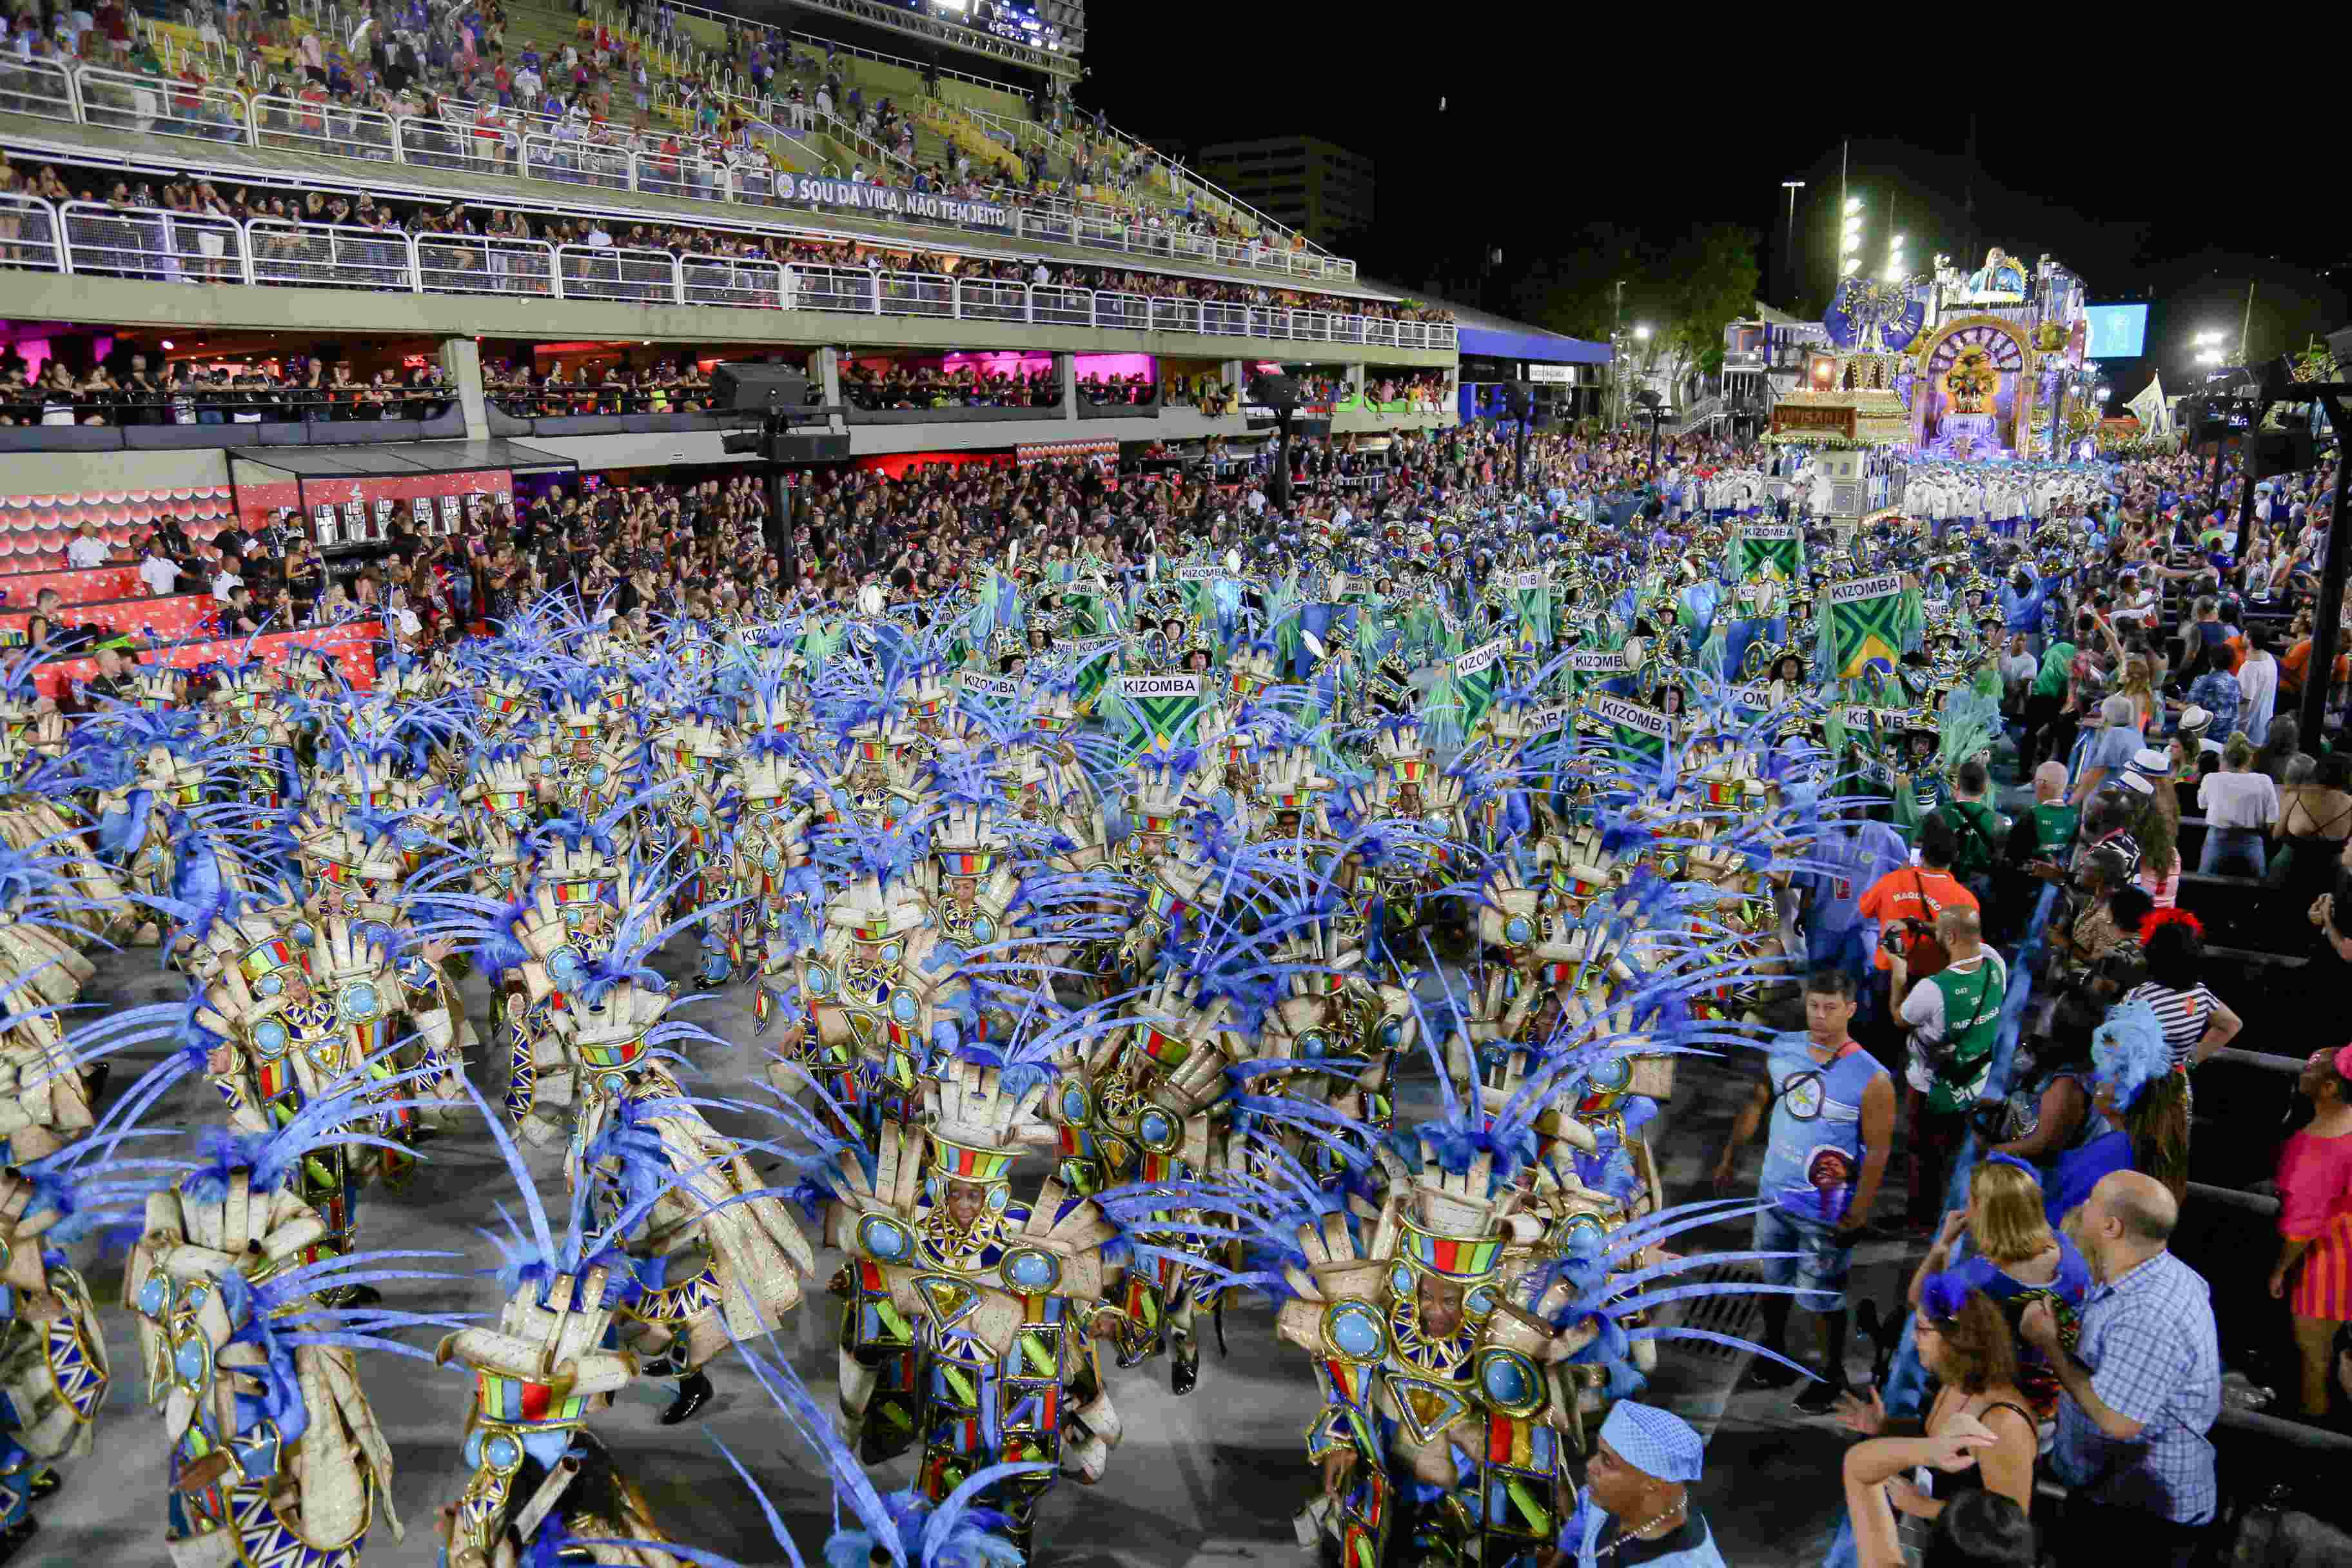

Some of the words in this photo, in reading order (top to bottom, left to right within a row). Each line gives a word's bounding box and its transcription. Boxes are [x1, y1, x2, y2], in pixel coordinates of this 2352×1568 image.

[799, 179, 834, 203] SOU
[838, 184, 861, 207] DA
[906, 194, 936, 217] NÃO
[939, 201, 968, 222] TEM
[971, 205, 1006, 226] JEITO
[1745, 527, 1794, 537] KIZOMBA
[1182, 567, 1228, 578] KIZOMBA
[1832, 577, 1898, 600] KIZOMBA
[1575, 655, 1623, 668] KIZOMB
[964, 673, 1016, 694] KIZOMBA
[1124, 679, 1195, 693] KIZOMBA
[1601, 700, 1665, 733] KIZOMB
[1847, 710, 1903, 729] KIZMB
